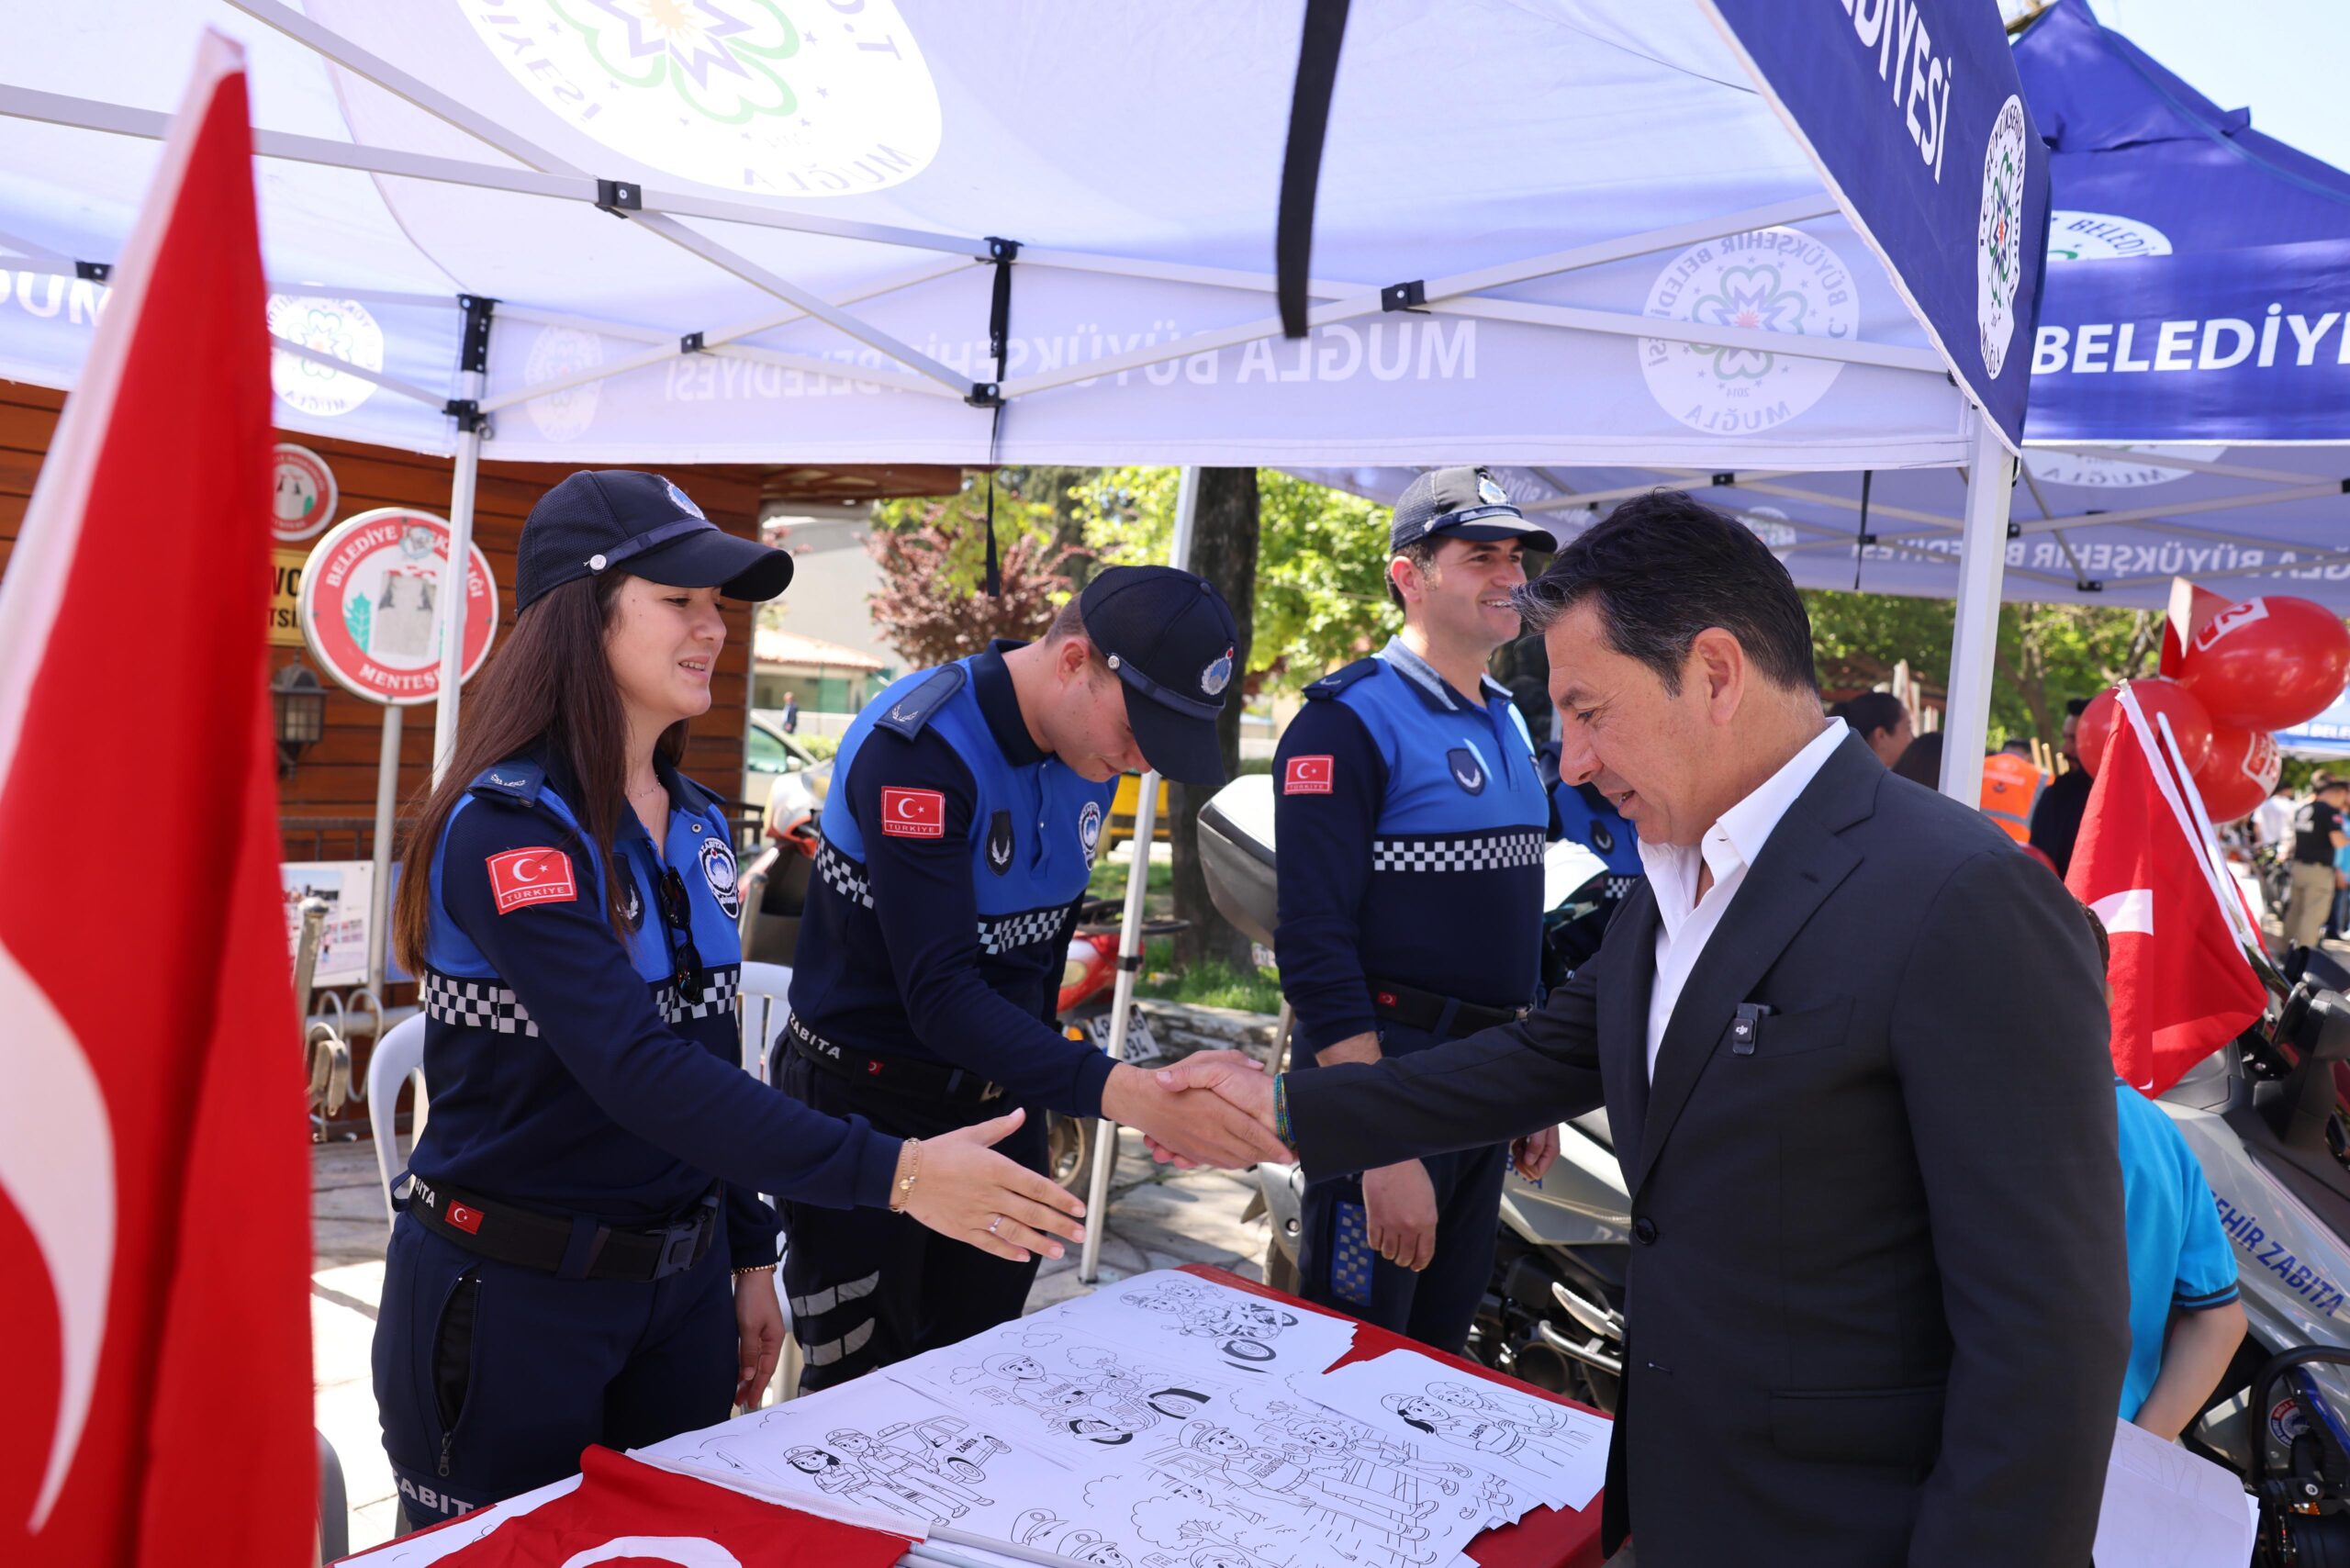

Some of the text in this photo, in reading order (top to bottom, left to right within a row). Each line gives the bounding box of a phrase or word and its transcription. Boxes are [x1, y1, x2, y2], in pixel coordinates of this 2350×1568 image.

[326, 525, 397, 588] BELEDİYE
[359, 662, 441, 691] MENTEŞ
[888, 823, 934, 834] TÜRKİYE
[507, 884, 565, 902] TÜRKİYE
[789, 1013, 841, 1059] ZABITA
[415, 1178, 436, 1209] BITA
[2211, 1191, 2344, 1317] EHİR ZABITA
[956, 1438, 979, 1453] ZABITA
[392, 1469, 475, 1518] ABIT
